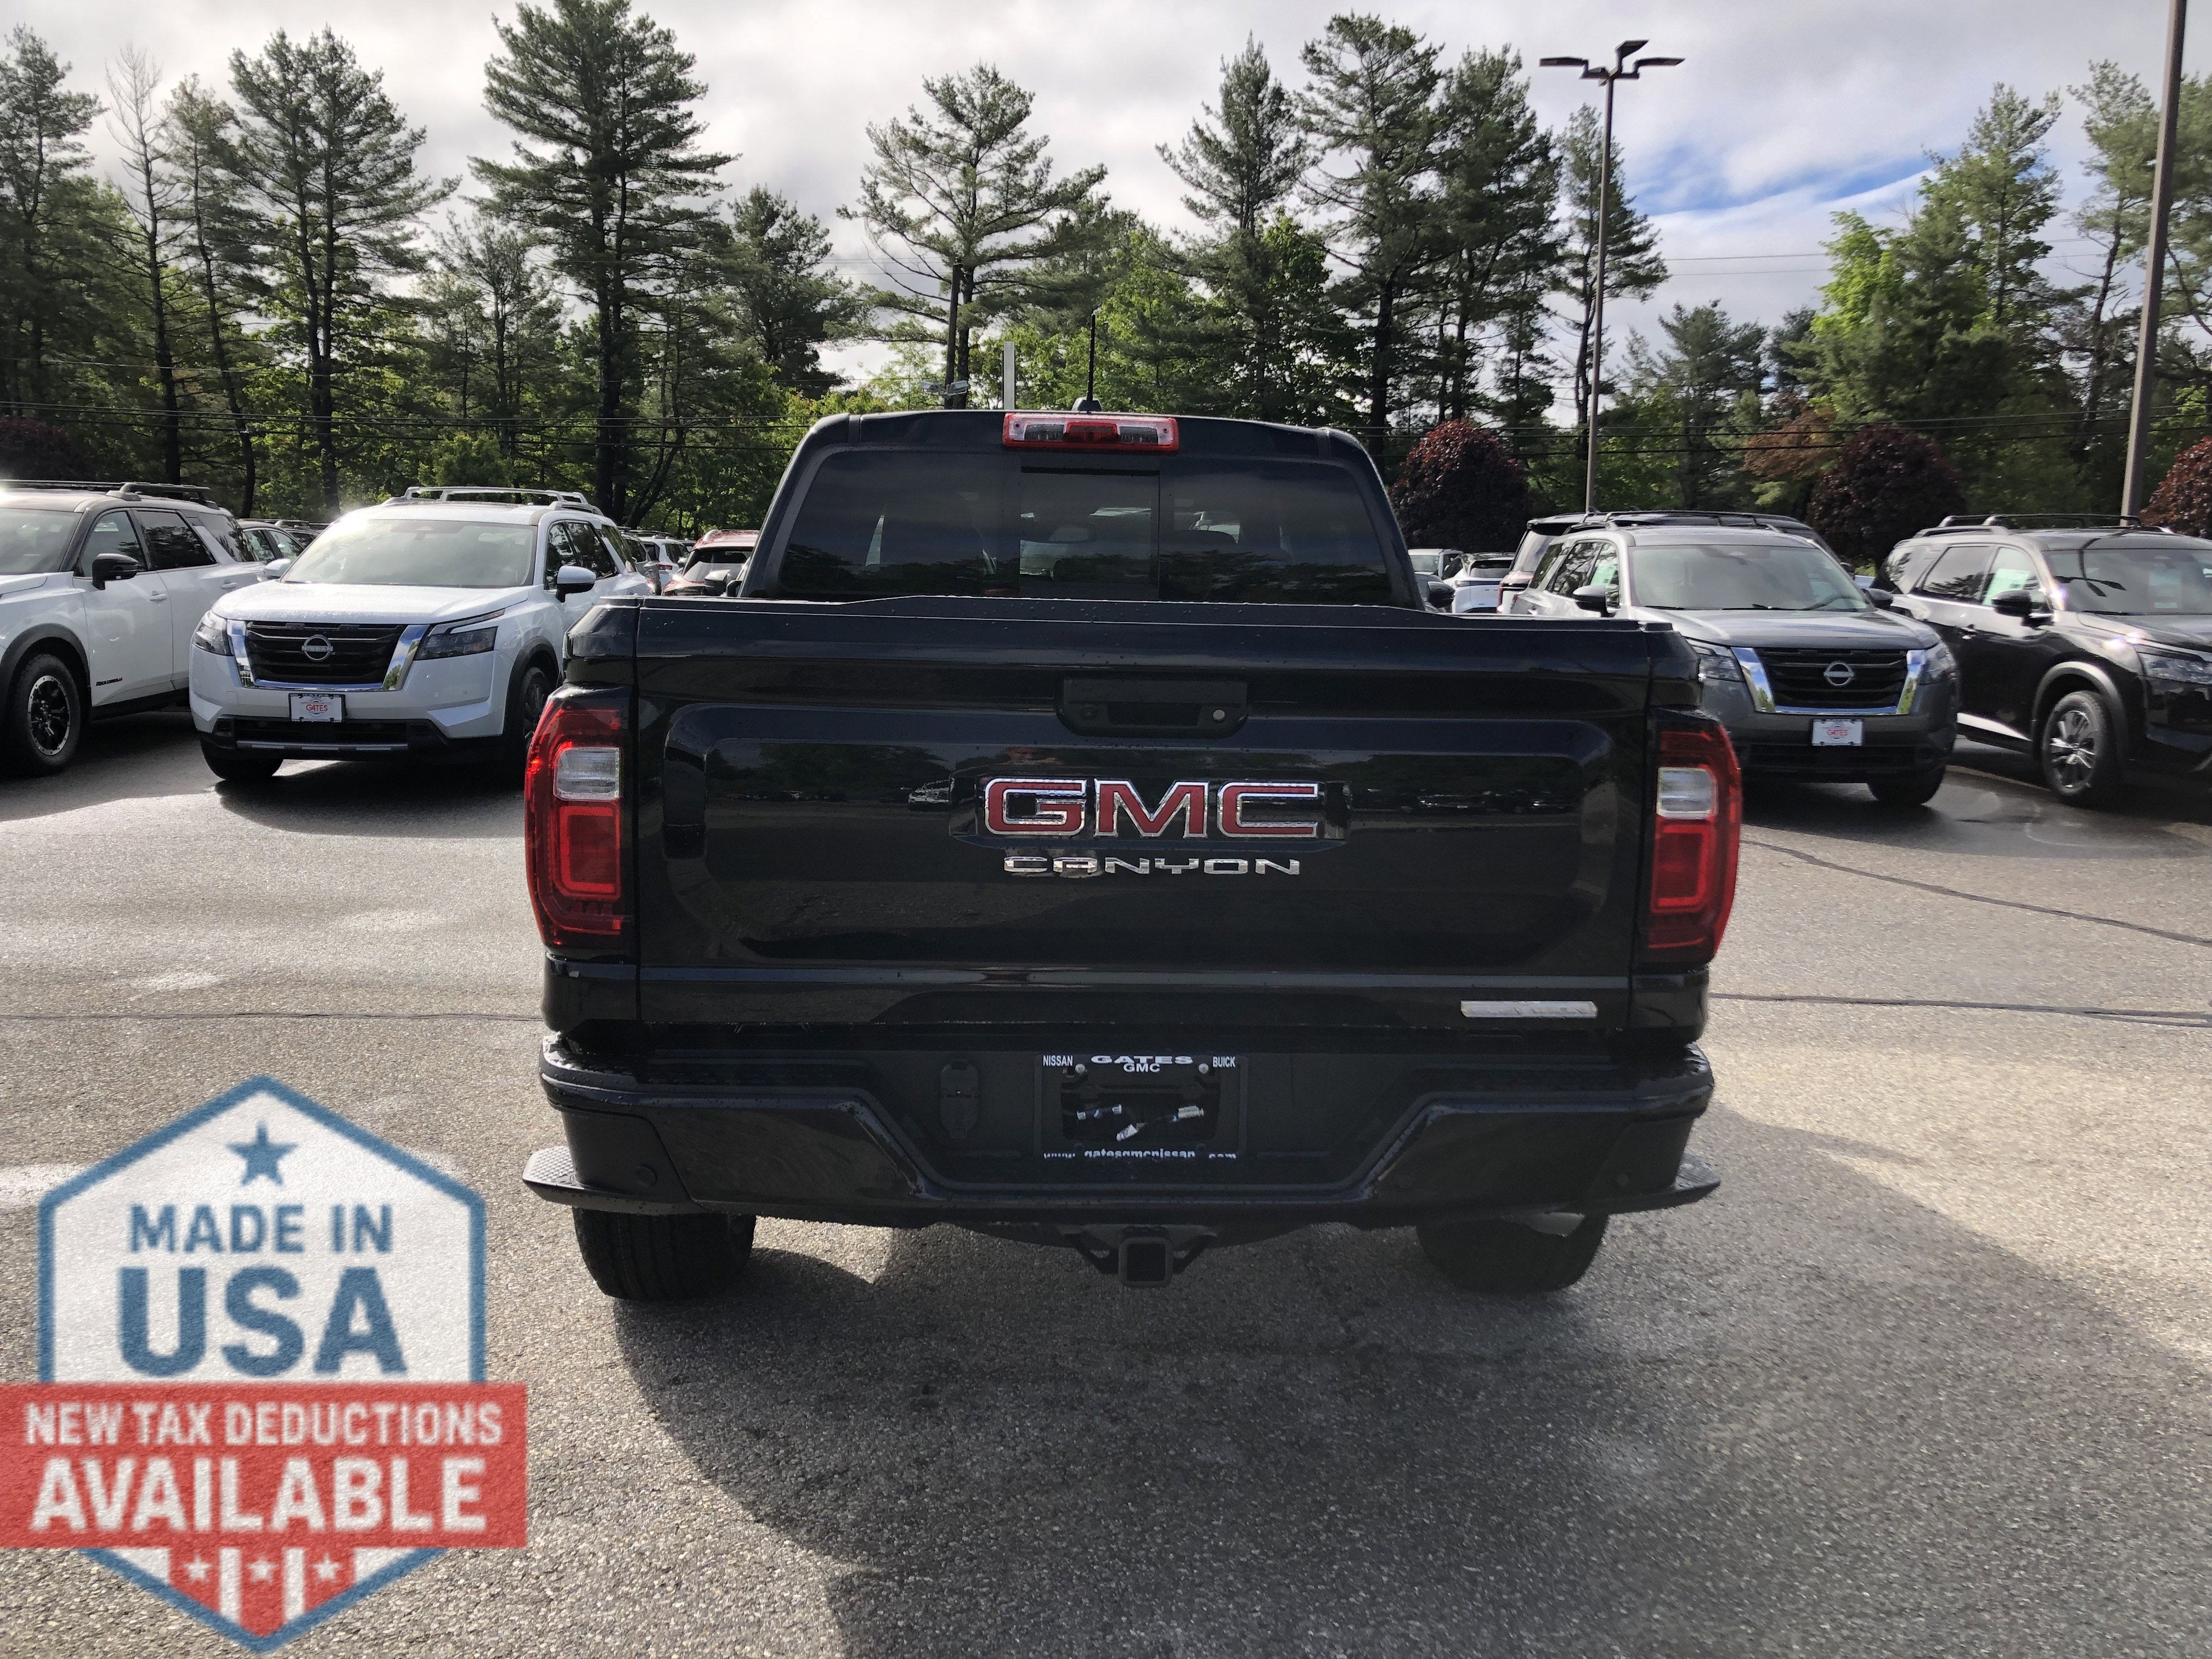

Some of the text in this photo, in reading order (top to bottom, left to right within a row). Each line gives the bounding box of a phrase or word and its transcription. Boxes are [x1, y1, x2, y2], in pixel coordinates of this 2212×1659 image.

[985, 777, 1318, 838] GMC
[1003, 856, 1301, 876] CANYON
[1043, 1054, 1073, 1066] NISSAN
[1091, 1055, 1193, 1065] GATES
[1212, 1056, 1235, 1068] BUICK
[1123, 1063, 1161, 1073] GMC
